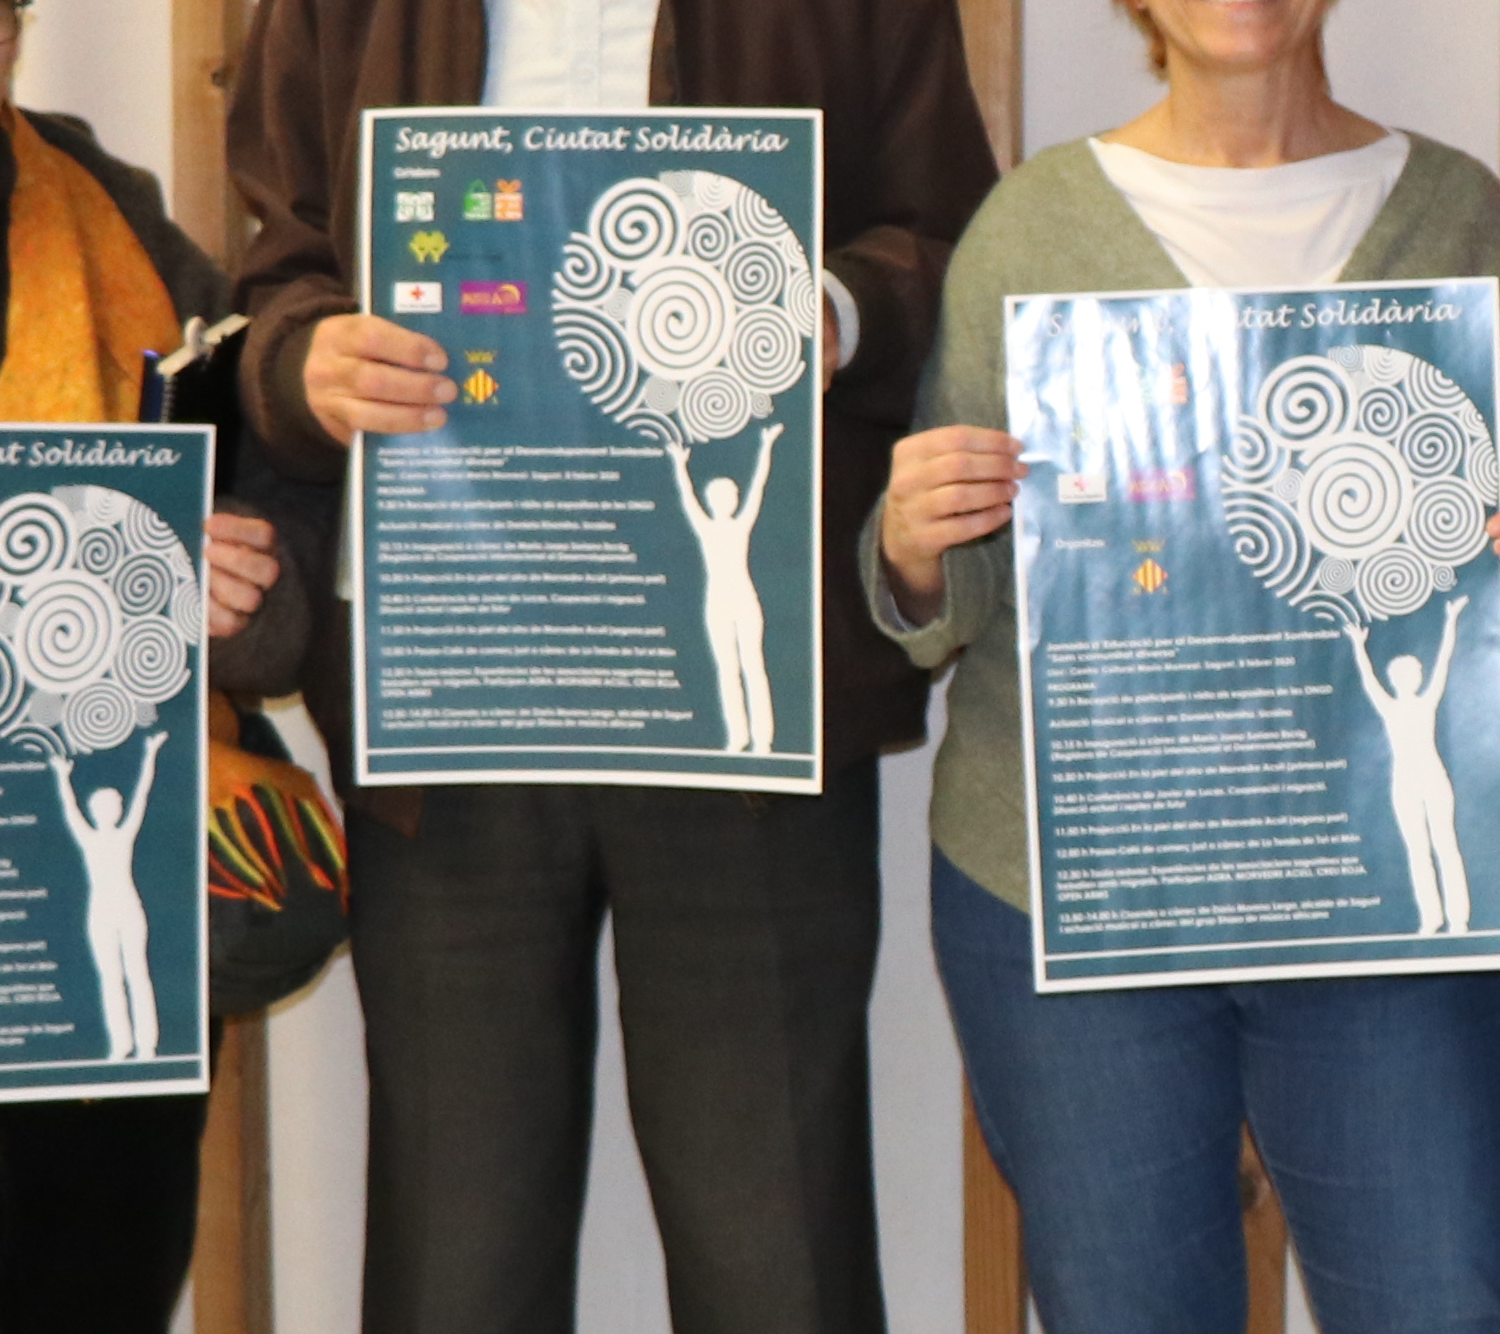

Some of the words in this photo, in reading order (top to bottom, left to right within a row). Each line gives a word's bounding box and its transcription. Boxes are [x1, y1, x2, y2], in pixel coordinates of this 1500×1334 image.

[395, 125, 513, 159] Sagunt,
[522, 125, 631, 151] Ciutat
[634, 124, 789, 153] Solidària
[1300, 298, 1461, 330] Solidària
[27, 438, 181, 467] Solidària
